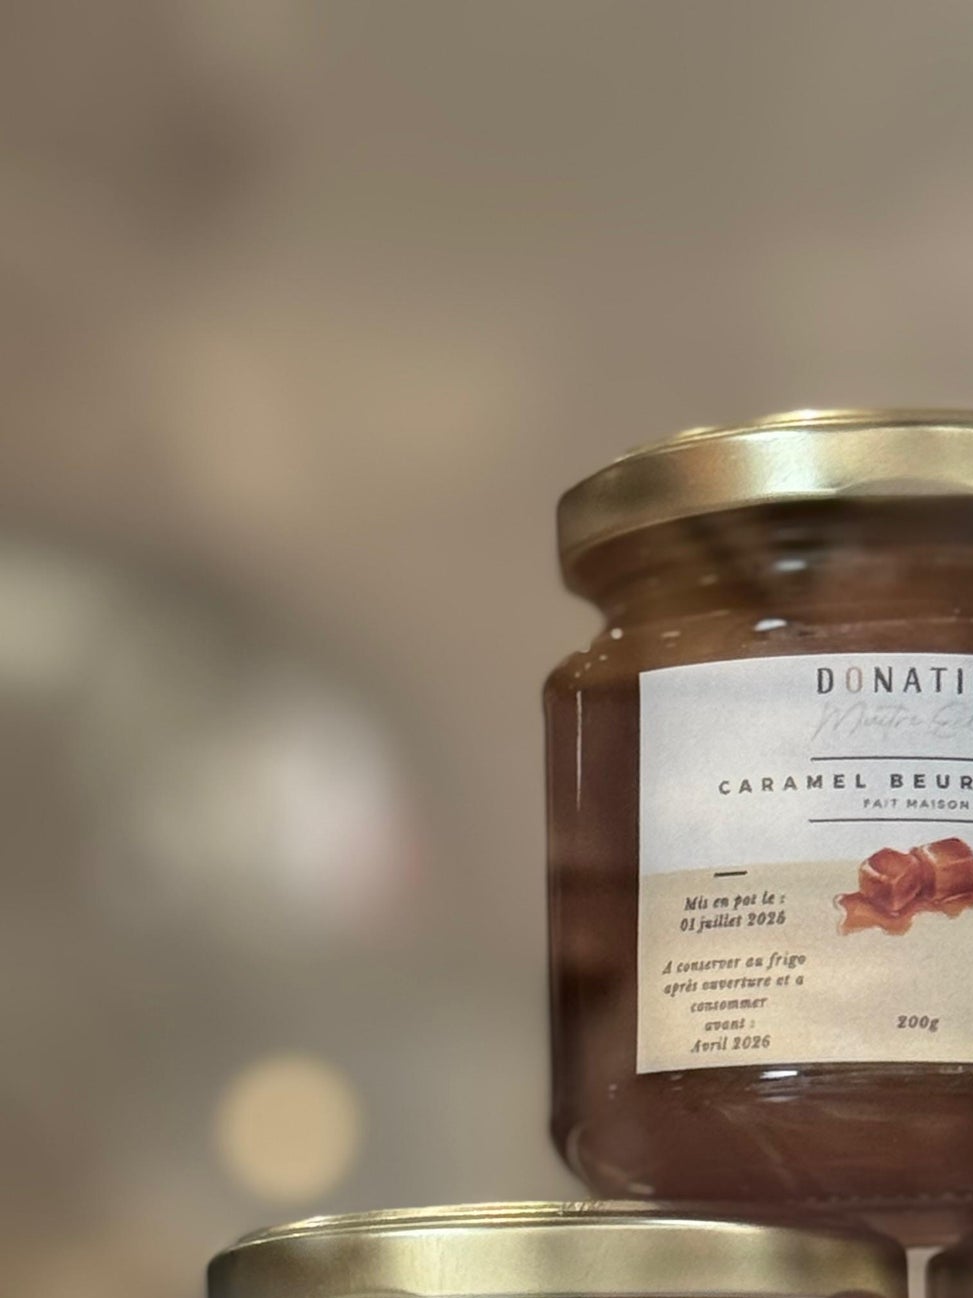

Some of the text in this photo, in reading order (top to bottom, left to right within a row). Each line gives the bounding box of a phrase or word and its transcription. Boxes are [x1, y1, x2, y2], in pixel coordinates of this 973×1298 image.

[718, 773, 867, 795] CARAMEL
[863, 799, 970, 811] FAIT MAISON
[684, 896, 708, 911] Mis
[713, 896, 729, 908] en
[733, 894, 757, 910] pot
[762, 891, 775, 905] le
[680, 917, 696, 932] 01
[697, 913, 743, 933] juillet
[676, 957, 742, 973] conserver
[745, 955, 763, 968] au
[766, 952, 807, 971] frigo
[663, 978, 698, 997] après
[702, 975, 772, 991] ouverture
[776, 974, 790, 987] et
[690, 997, 769, 1013] consommer
[704, 1017, 746, 1031] avant
[897, 1014, 940, 1033] 200g
[690, 1034, 771, 1053] Avril 2026
